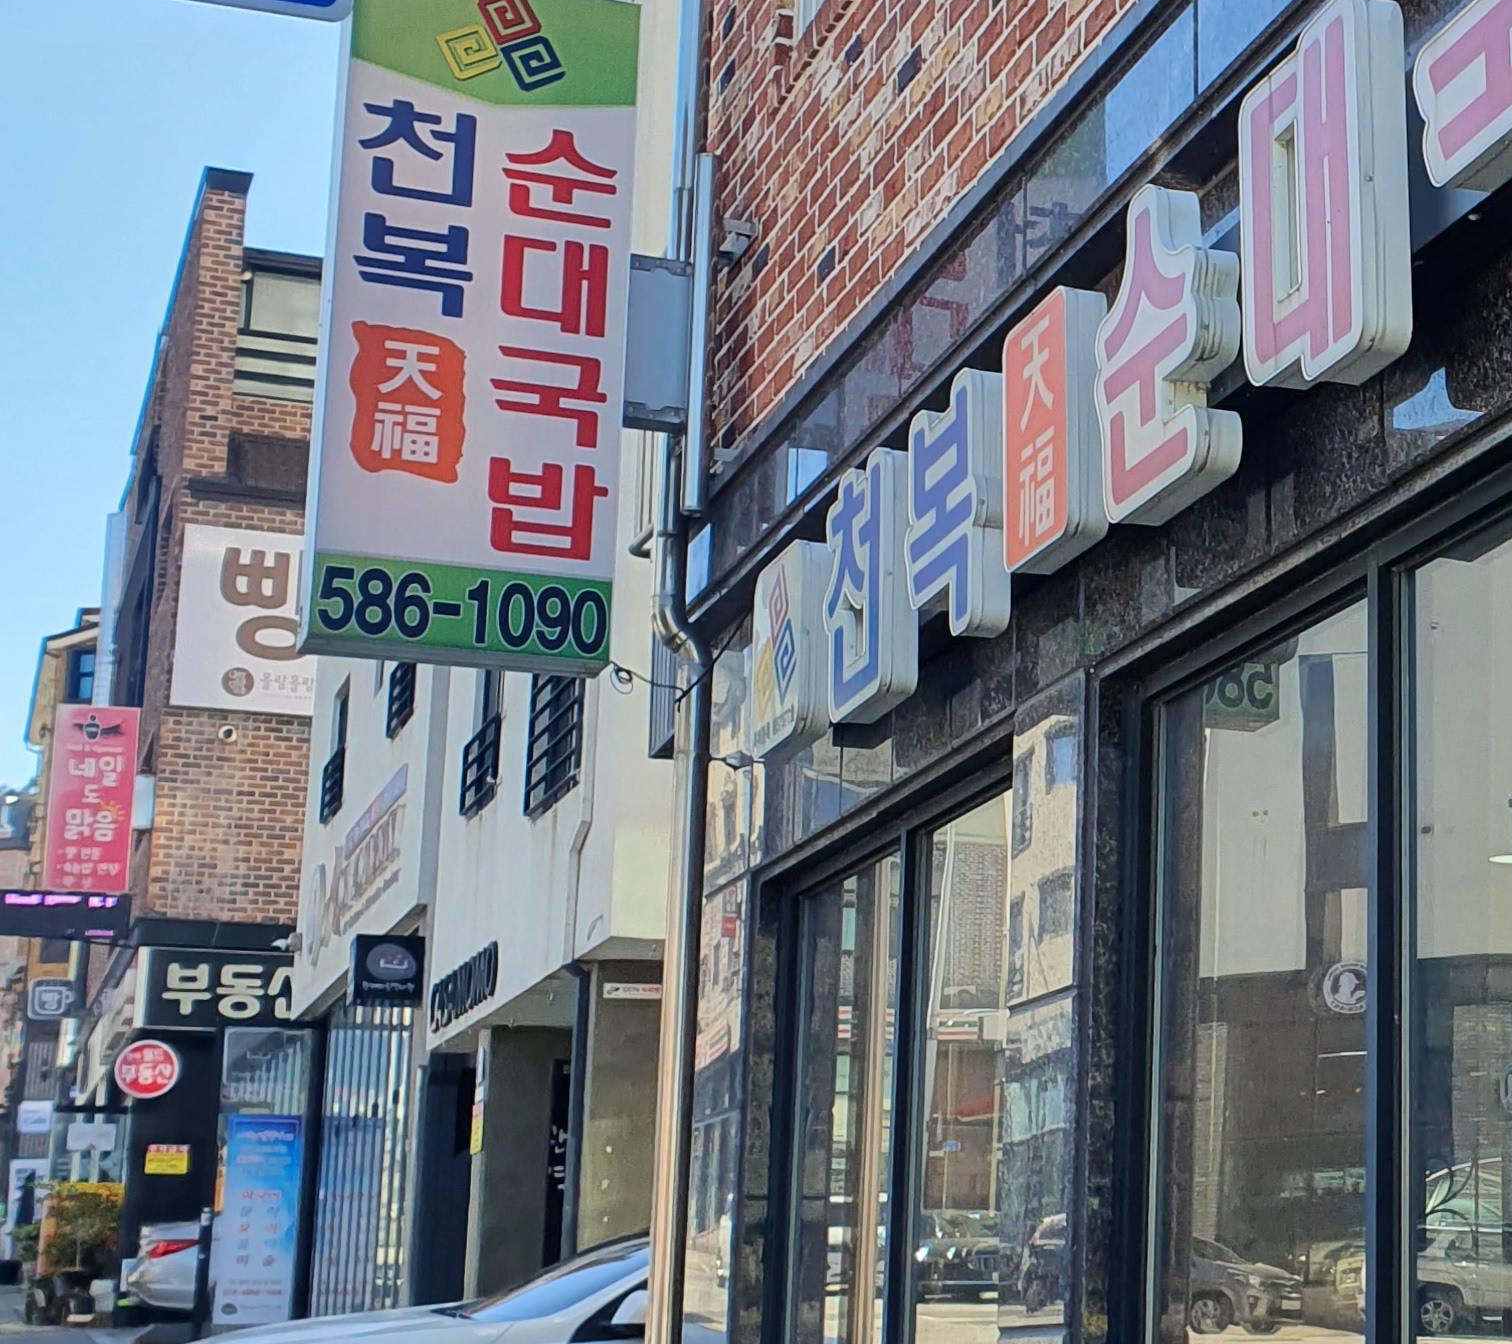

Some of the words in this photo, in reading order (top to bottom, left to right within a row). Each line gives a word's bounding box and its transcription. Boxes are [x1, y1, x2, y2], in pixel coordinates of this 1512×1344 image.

[352, 99, 478, 319] 천복
[370, 340, 444, 465] 天福
[486, 128, 619, 562] 순대국밥
[1016, 317, 1056, 547] 天福
[827, 384, 974, 710] 천복
[317, 564, 609, 656] 586-1090
[63, 808, 118, 844] 맑음
[67, 755, 125, 788] 네일
[121, 1062, 174, 1085] 부동산
